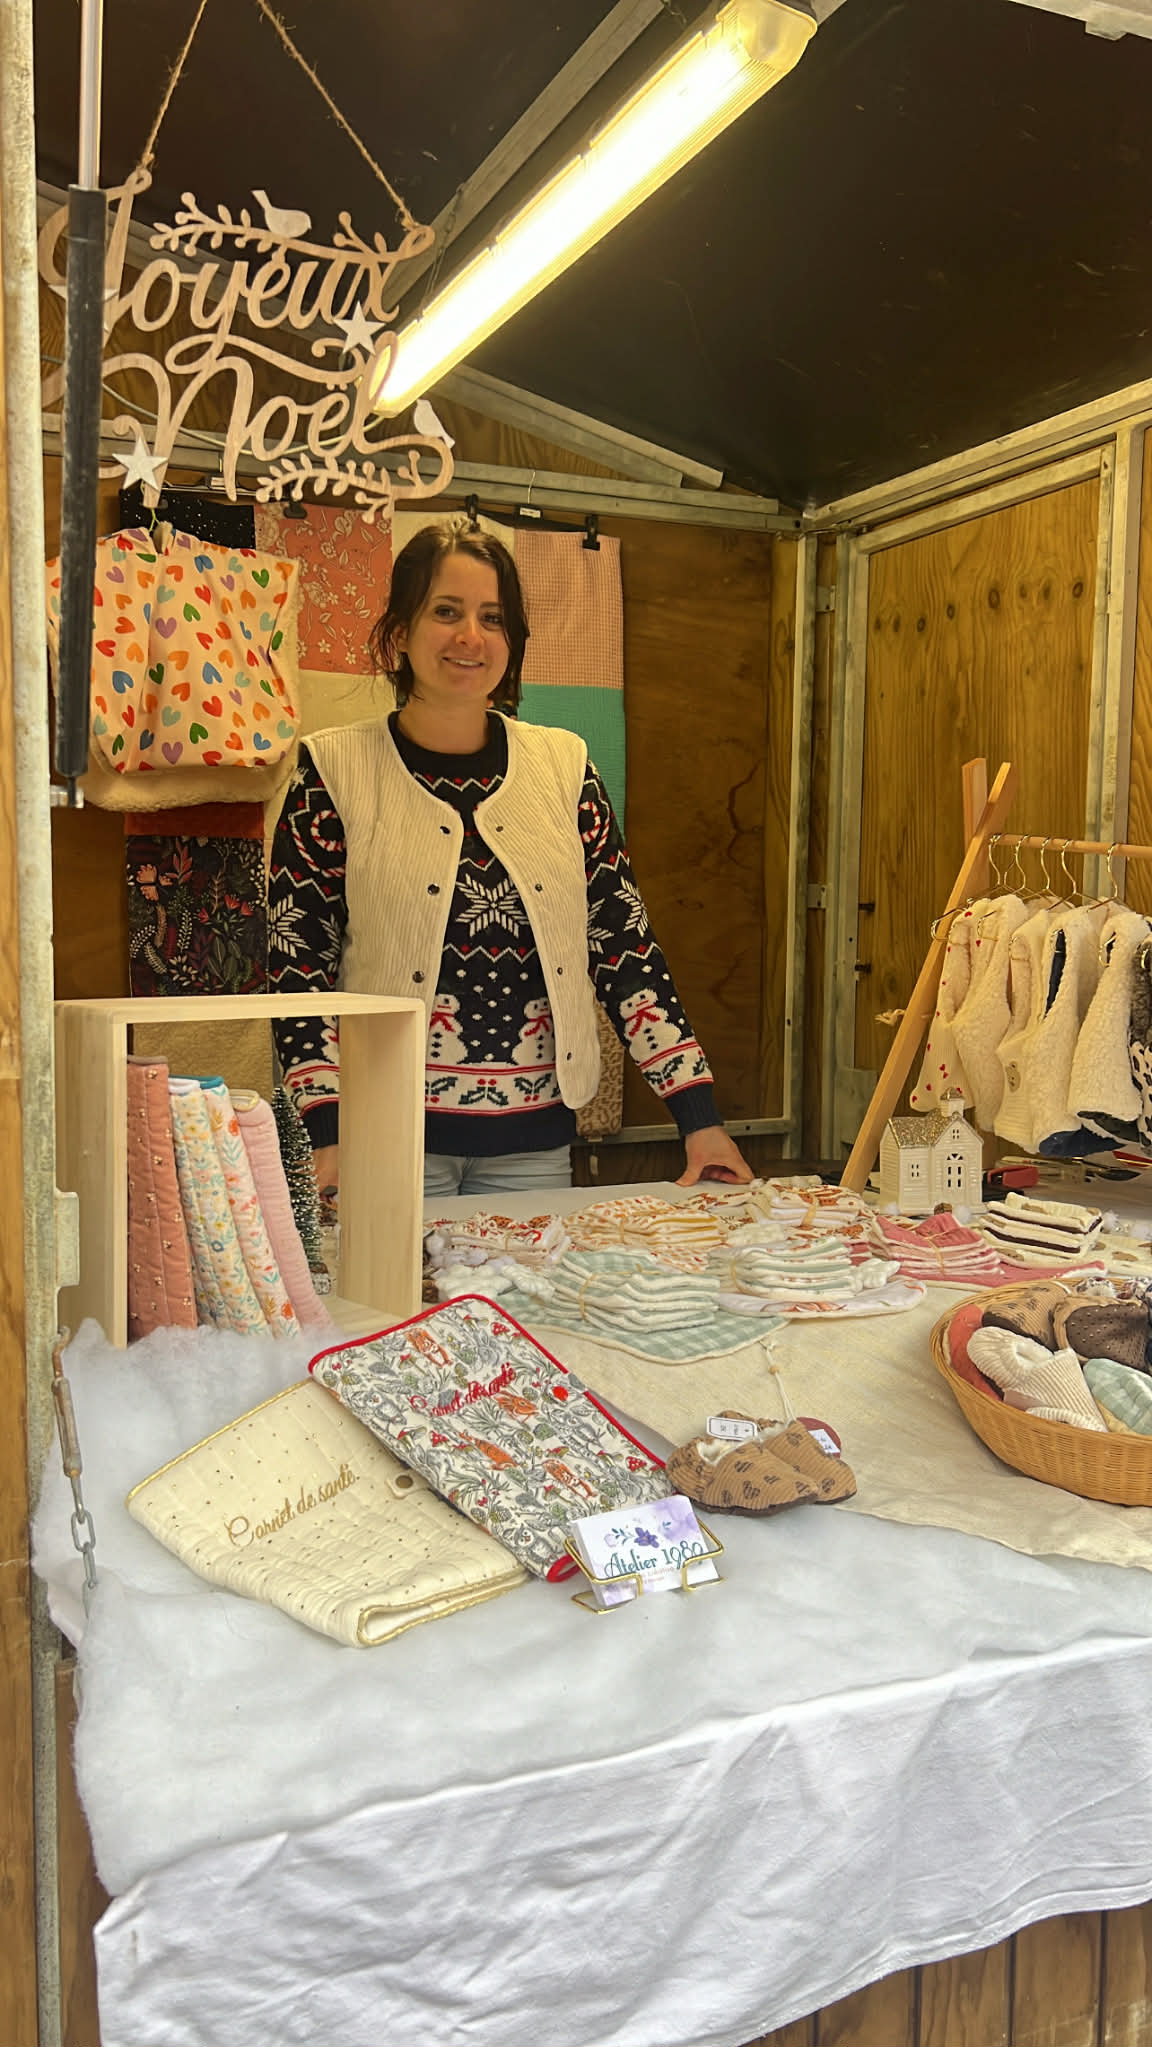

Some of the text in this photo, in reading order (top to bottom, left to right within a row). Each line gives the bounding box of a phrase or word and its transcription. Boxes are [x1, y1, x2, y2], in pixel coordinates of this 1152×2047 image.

[38, 170, 400, 376] Joyeux
[224, 1463, 356, 1547] Carnet de santé
[604, 1548, 657, 1577] Atelier
